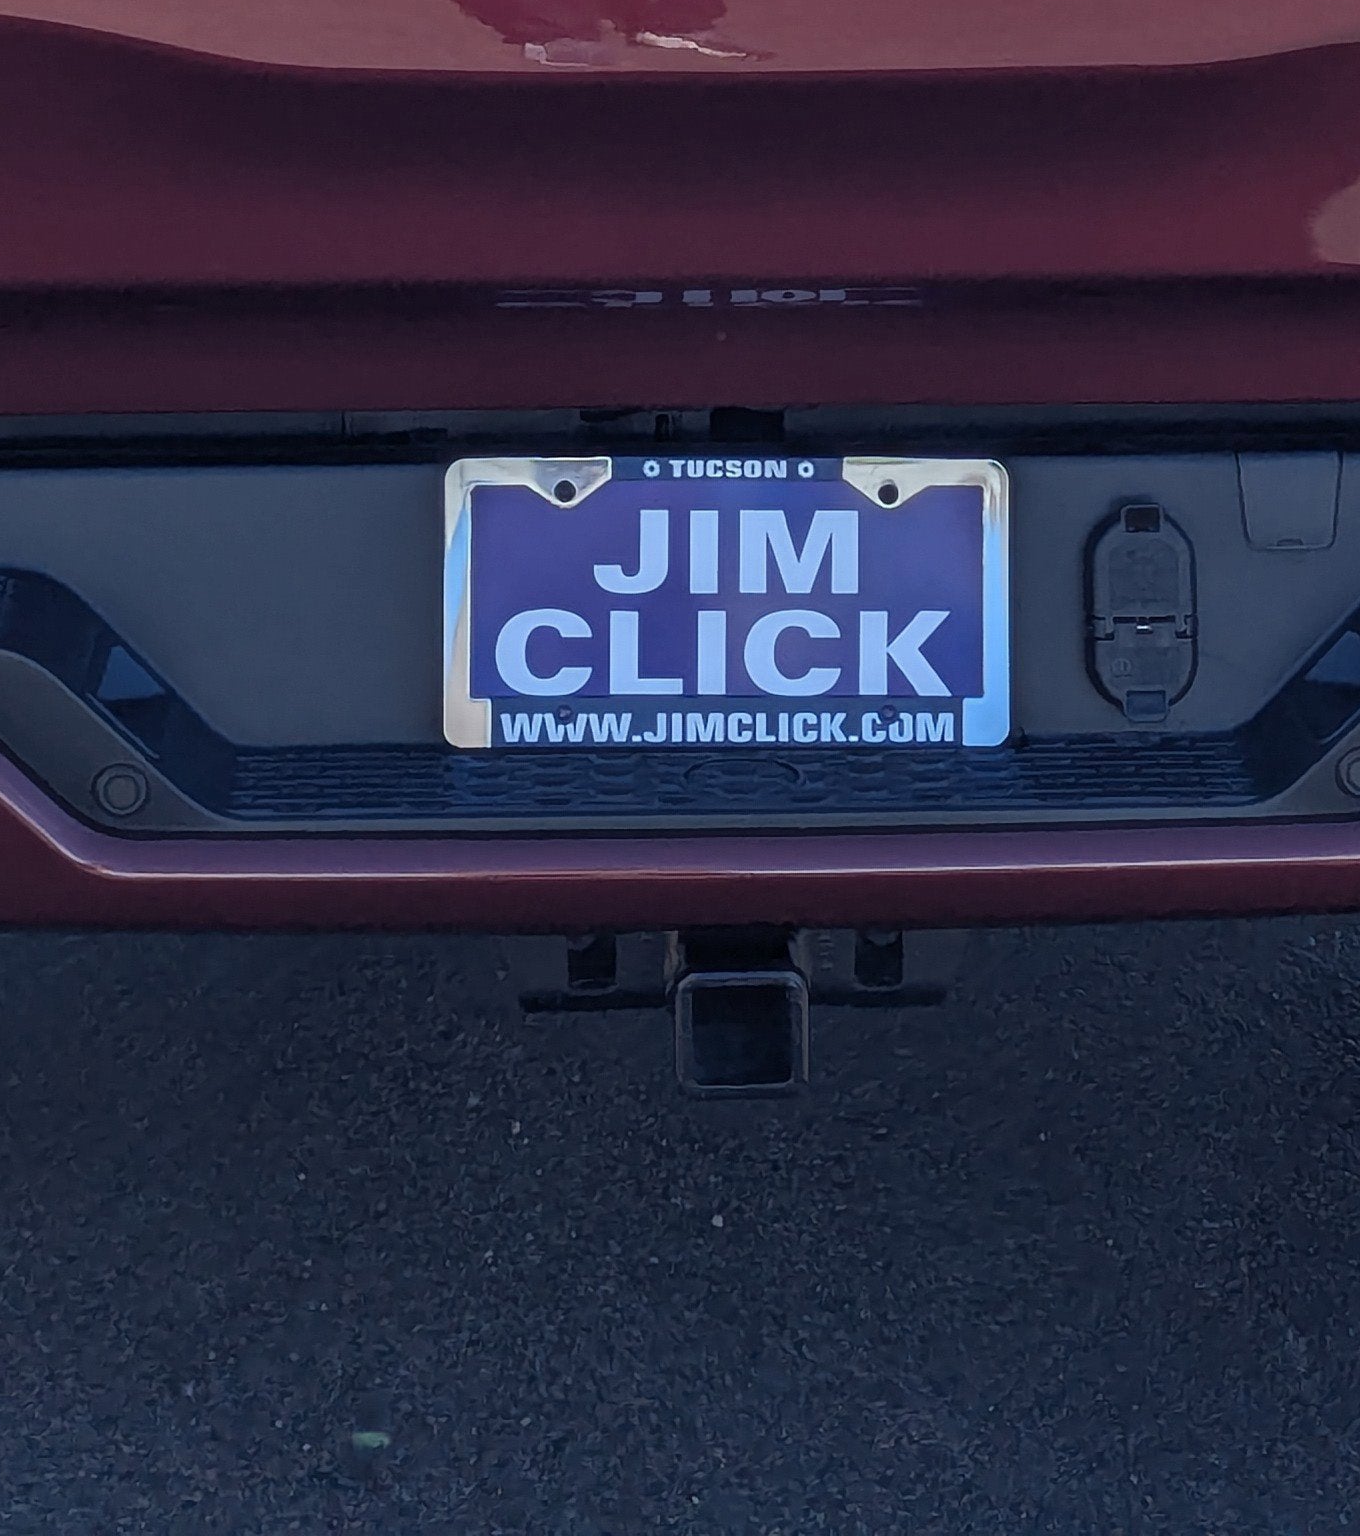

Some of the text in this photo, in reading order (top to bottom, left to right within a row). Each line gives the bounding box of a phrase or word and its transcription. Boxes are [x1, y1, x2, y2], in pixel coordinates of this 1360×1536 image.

[670, 459, 788, 479] TUCSON
[593, 509, 859, 595] JIM
[495, 608, 953, 697] CLICK
[500, 711, 956, 744] WWW.JIMCLICK.COM
